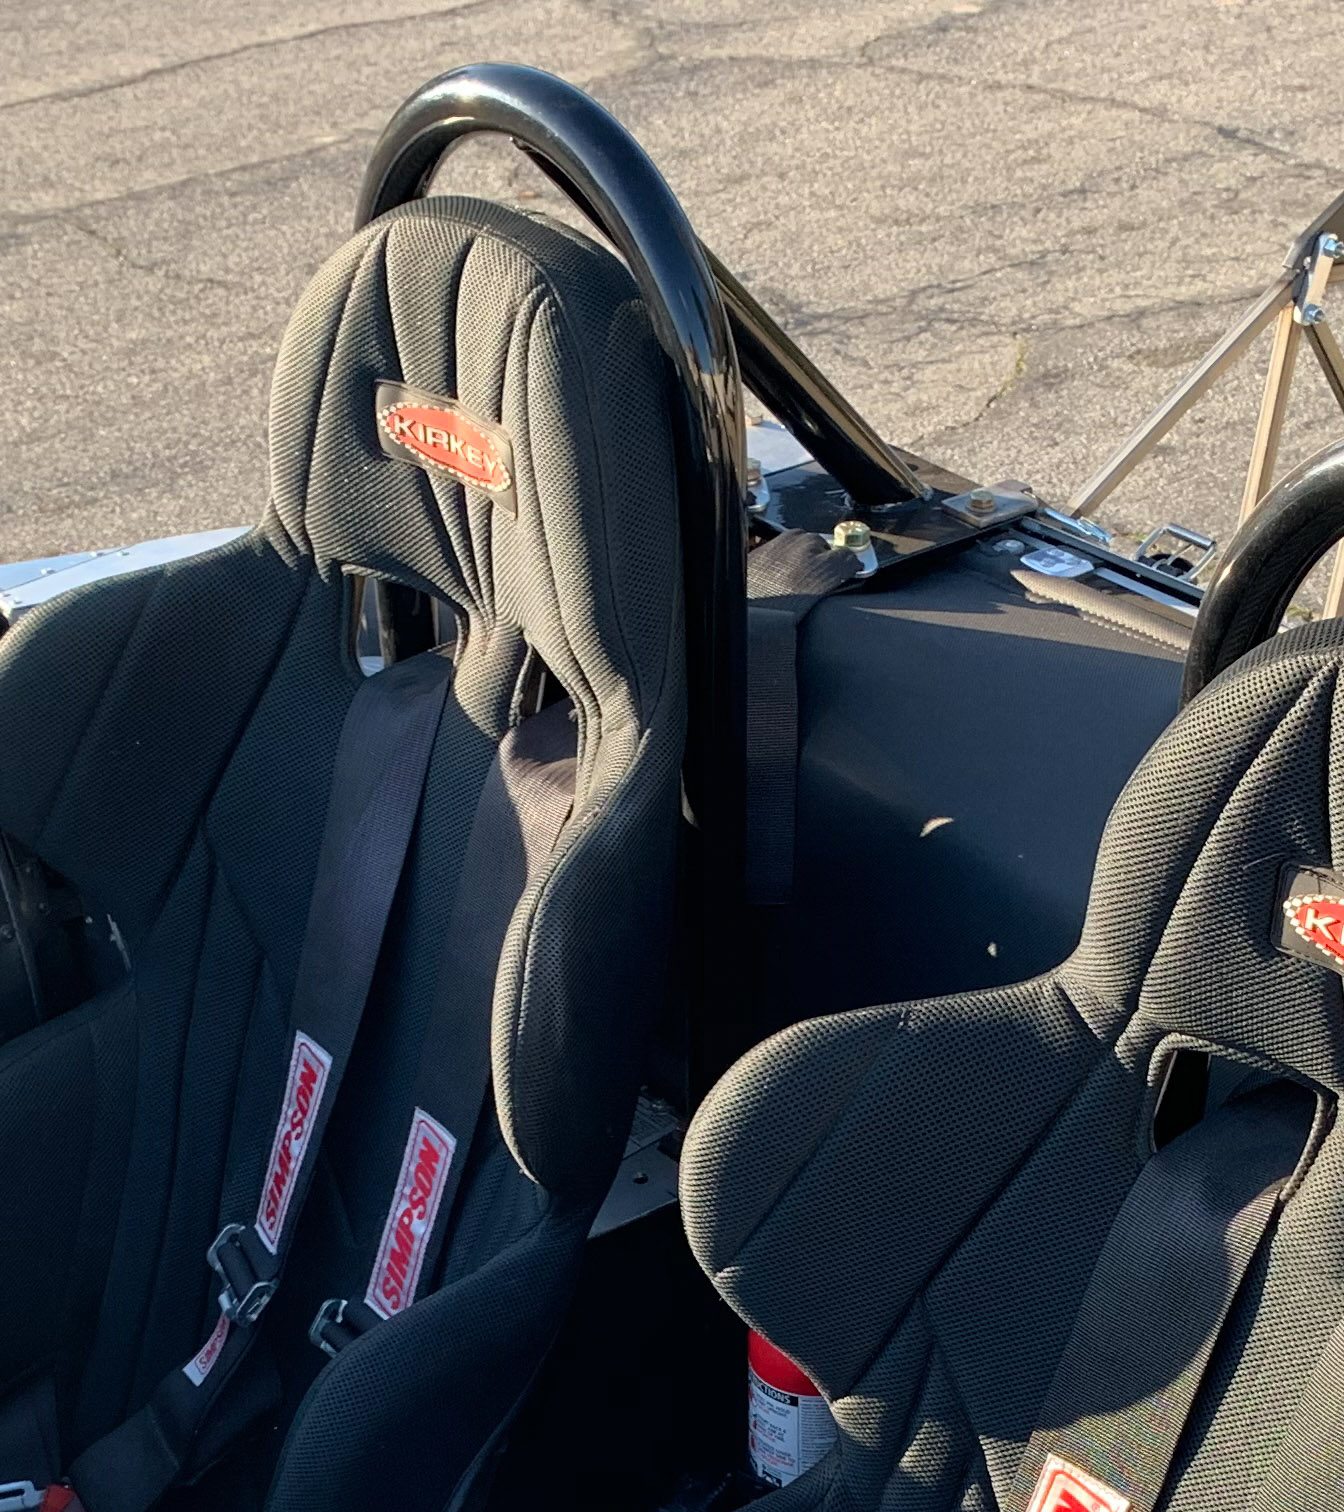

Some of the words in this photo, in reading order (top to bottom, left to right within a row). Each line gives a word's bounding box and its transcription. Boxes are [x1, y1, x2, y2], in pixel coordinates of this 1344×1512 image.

[393, 413, 499, 478] KIRKEY
[265, 1058, 319, 1231] SIMPSON
[381, 1135, 441, 1311] SIMPSON
